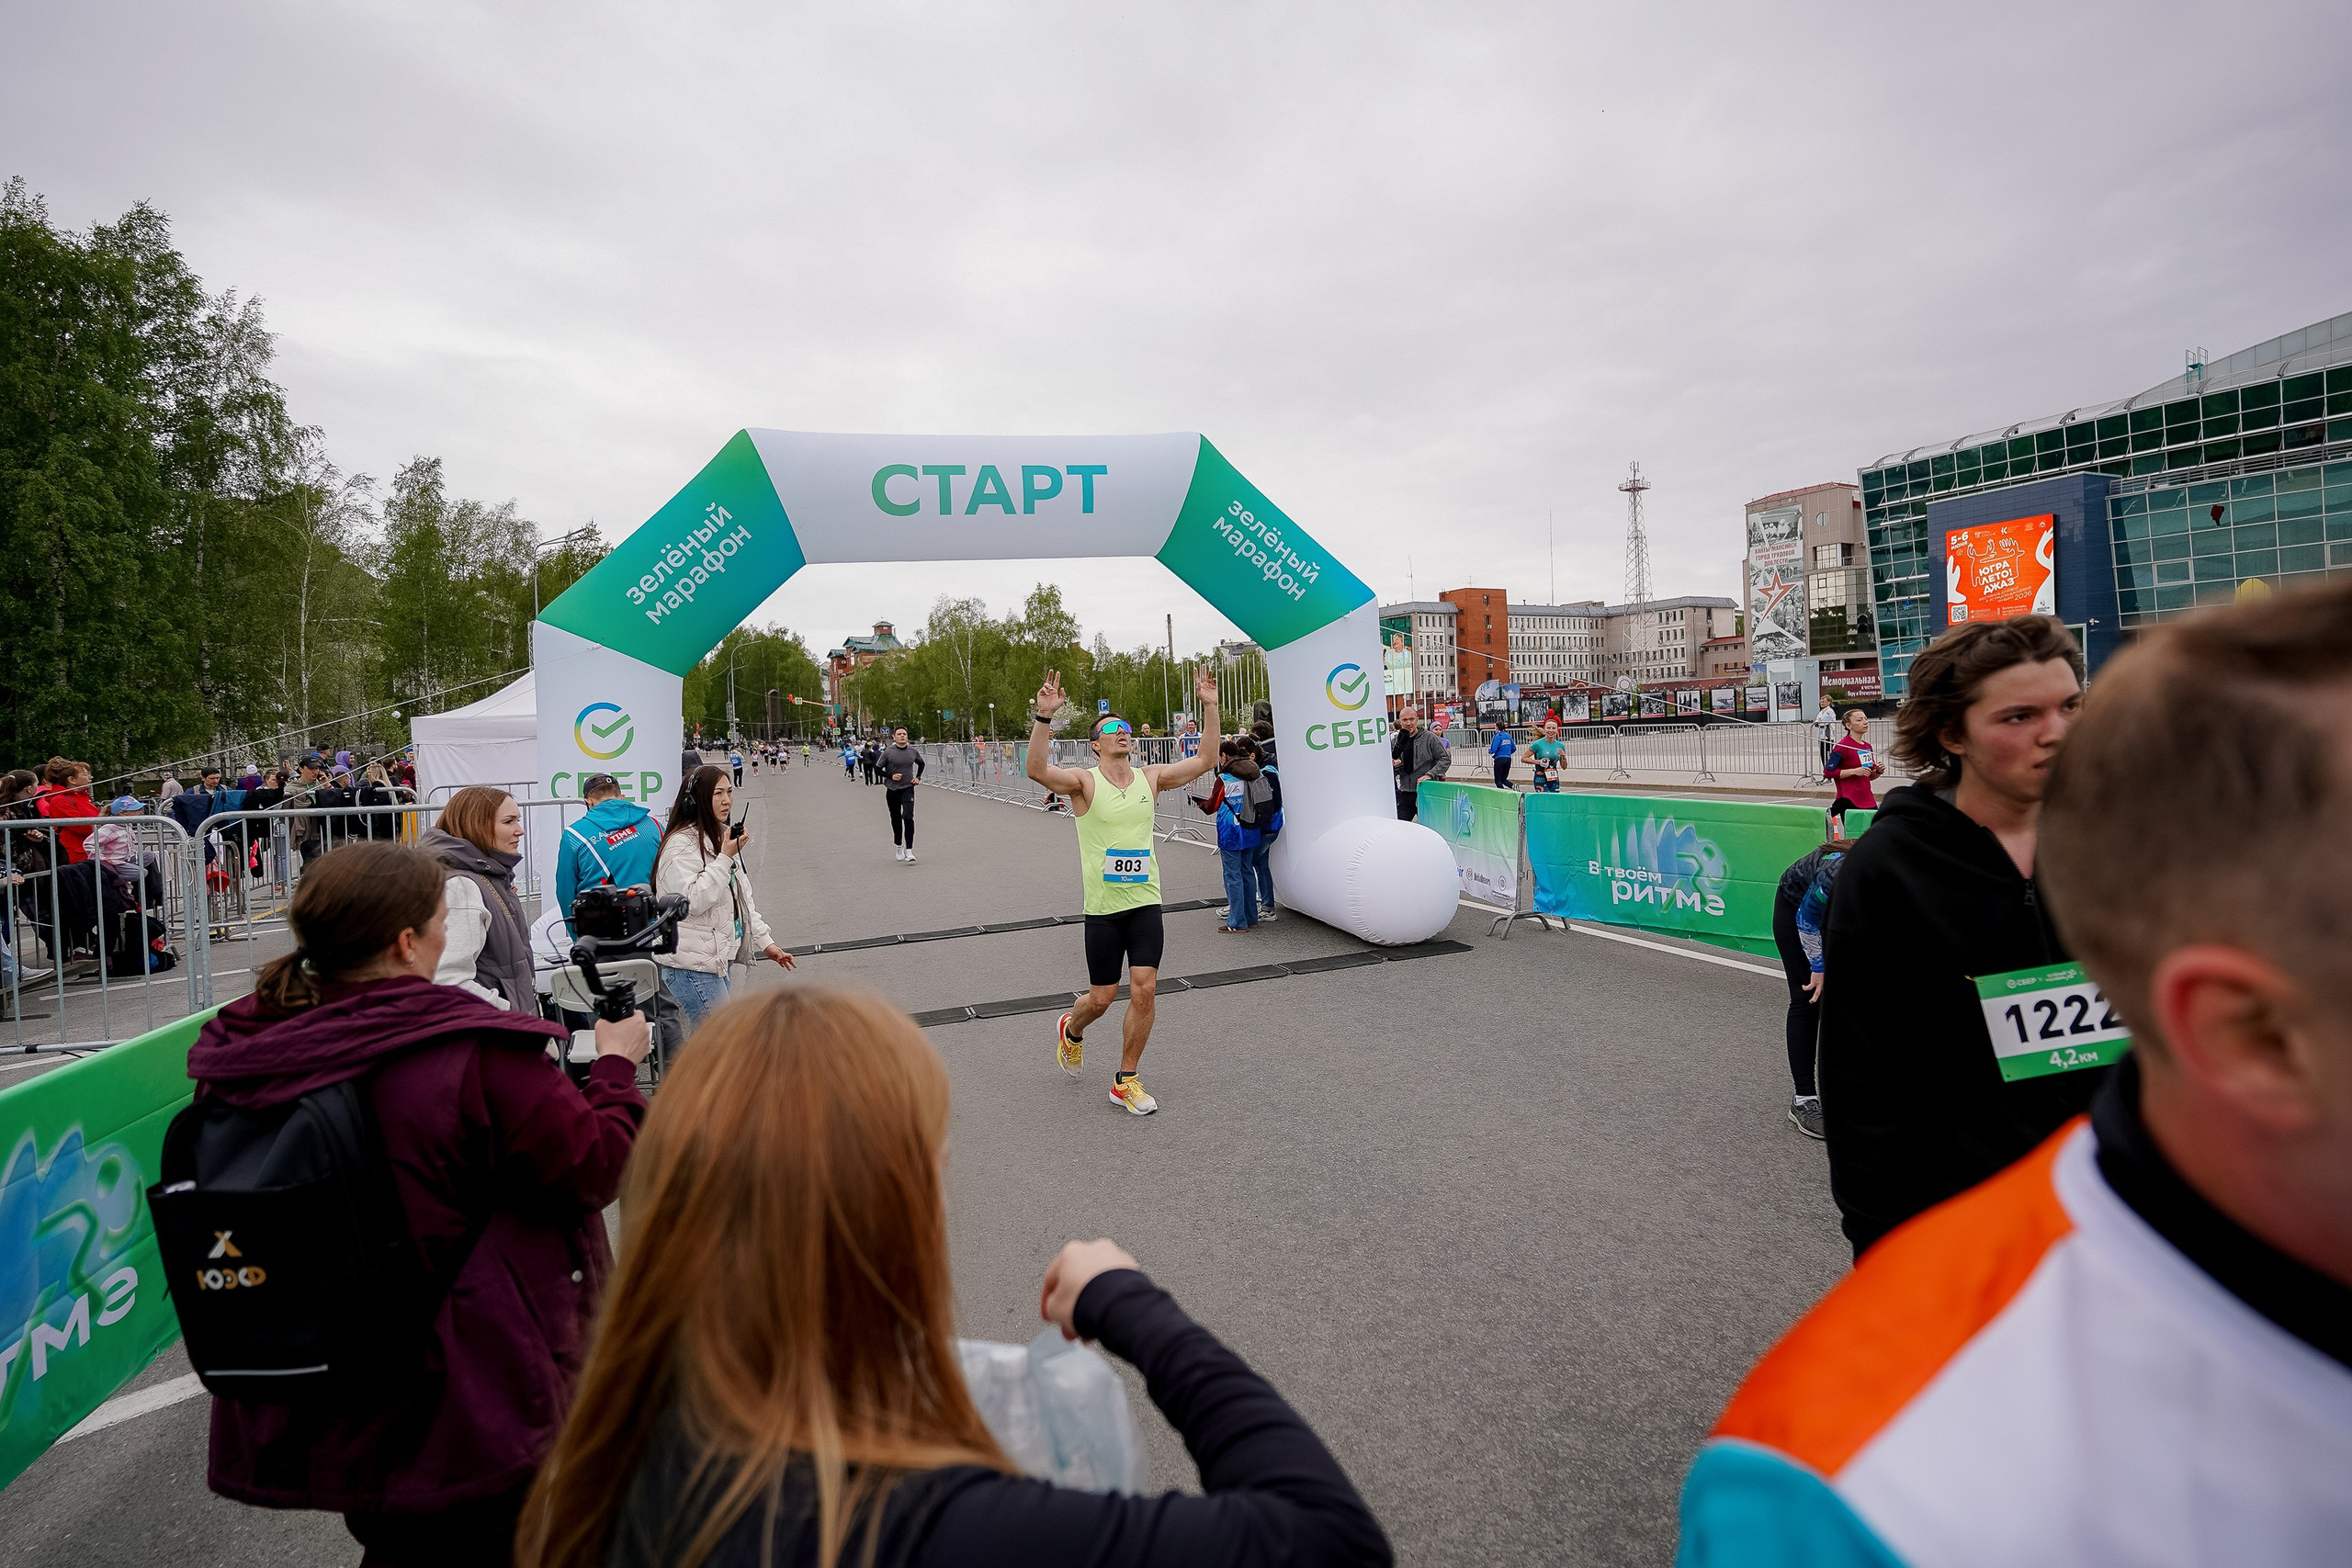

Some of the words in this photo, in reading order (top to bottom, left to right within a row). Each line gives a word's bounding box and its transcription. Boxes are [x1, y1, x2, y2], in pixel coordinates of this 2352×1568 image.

[872, 463, 1107, 517] СТАРТ
[1227, 499, 1322, 584] зелёный
[1951, 532, 1969, 545] 5-6
[626, 502, 734, 605] зелёный
[1212, 516, 1306, 602] марафон
[645, 524, 752, 626] марафон
[1979, 560, 2010, 576] ЮГРА
[1981, 569, 2013, 585] ЛЕТО!
[1984, 579, 2015, 595] ДЖАЗ
[2014, 591, 2032, 602] 2026
[1821, 675, 1875, 687] Мемориальная
[1306, 717, 1386, 752] СБЕР
[610, 829, 633, 842] TIME
[1114, 859, 1142, 872] 803
[1589, 860, 1600, 875] В
[1604, 865, 1662, 884] твоём
